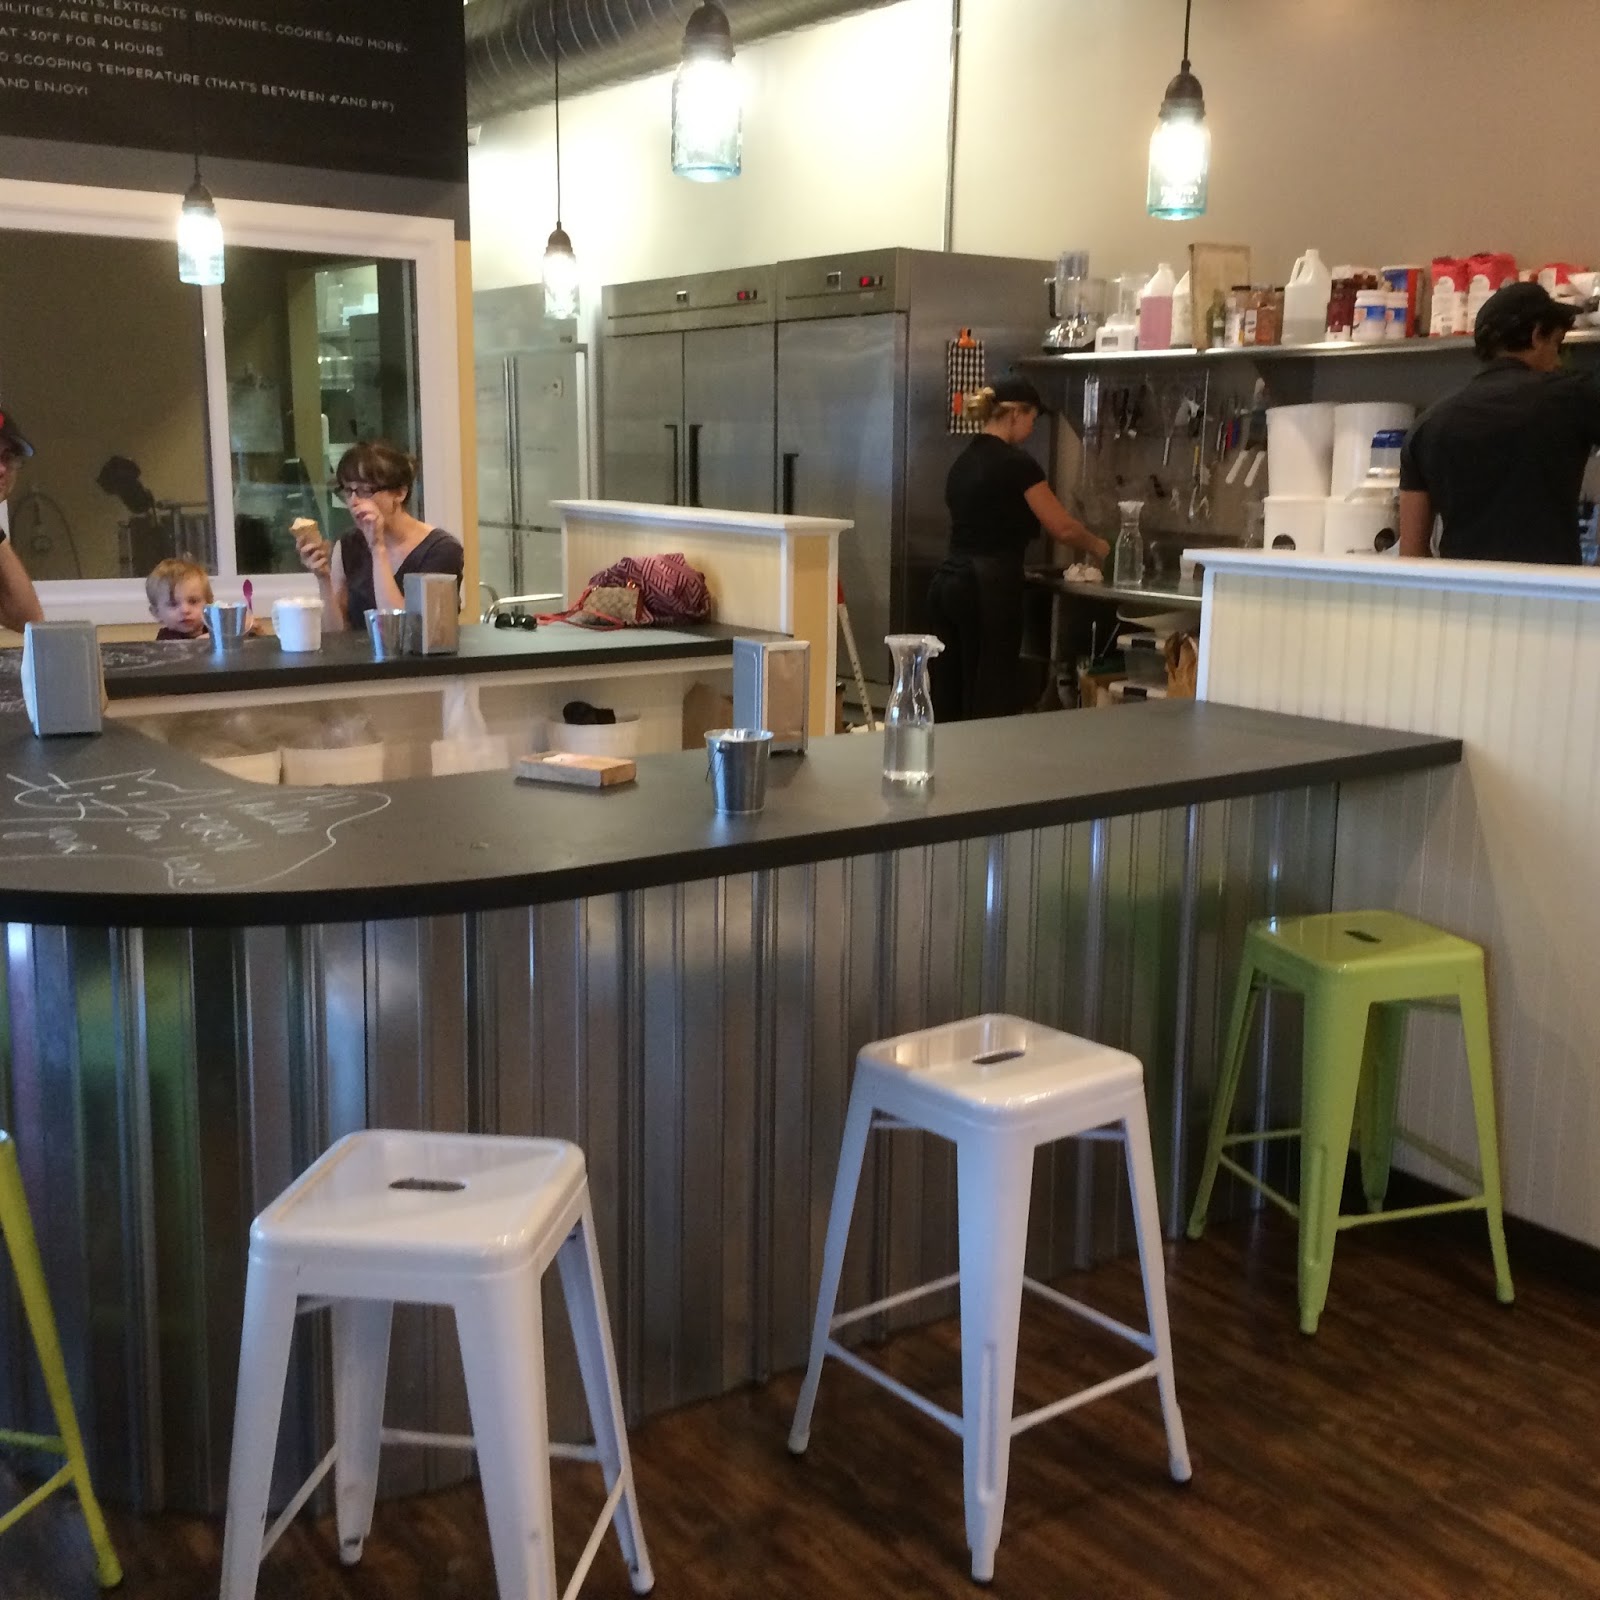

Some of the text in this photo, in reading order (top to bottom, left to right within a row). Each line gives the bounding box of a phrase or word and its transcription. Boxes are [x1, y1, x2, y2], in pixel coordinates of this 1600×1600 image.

[59, 9, 89, 22] ARE
[94, 13, 163, 32] ENDLESS!
[67, 0, 110, 9] TS,
[275, 23, 332, 43] COOKIES
[336, 34, 363, 47] AND
[65, 33, 96, 48] FOR
[101, 39, 110, 50] 4
[114, 41, 164, 57] HOURS
[14, 52, 93, 73] SCOOPING
[97, 62, 201, 86] TEMPERATURE
[205, 77, 258, 94] (THAT'S
[261, 84, 325, 103] BETWEEN
[34, 80, 89, 96] ENJOY!
